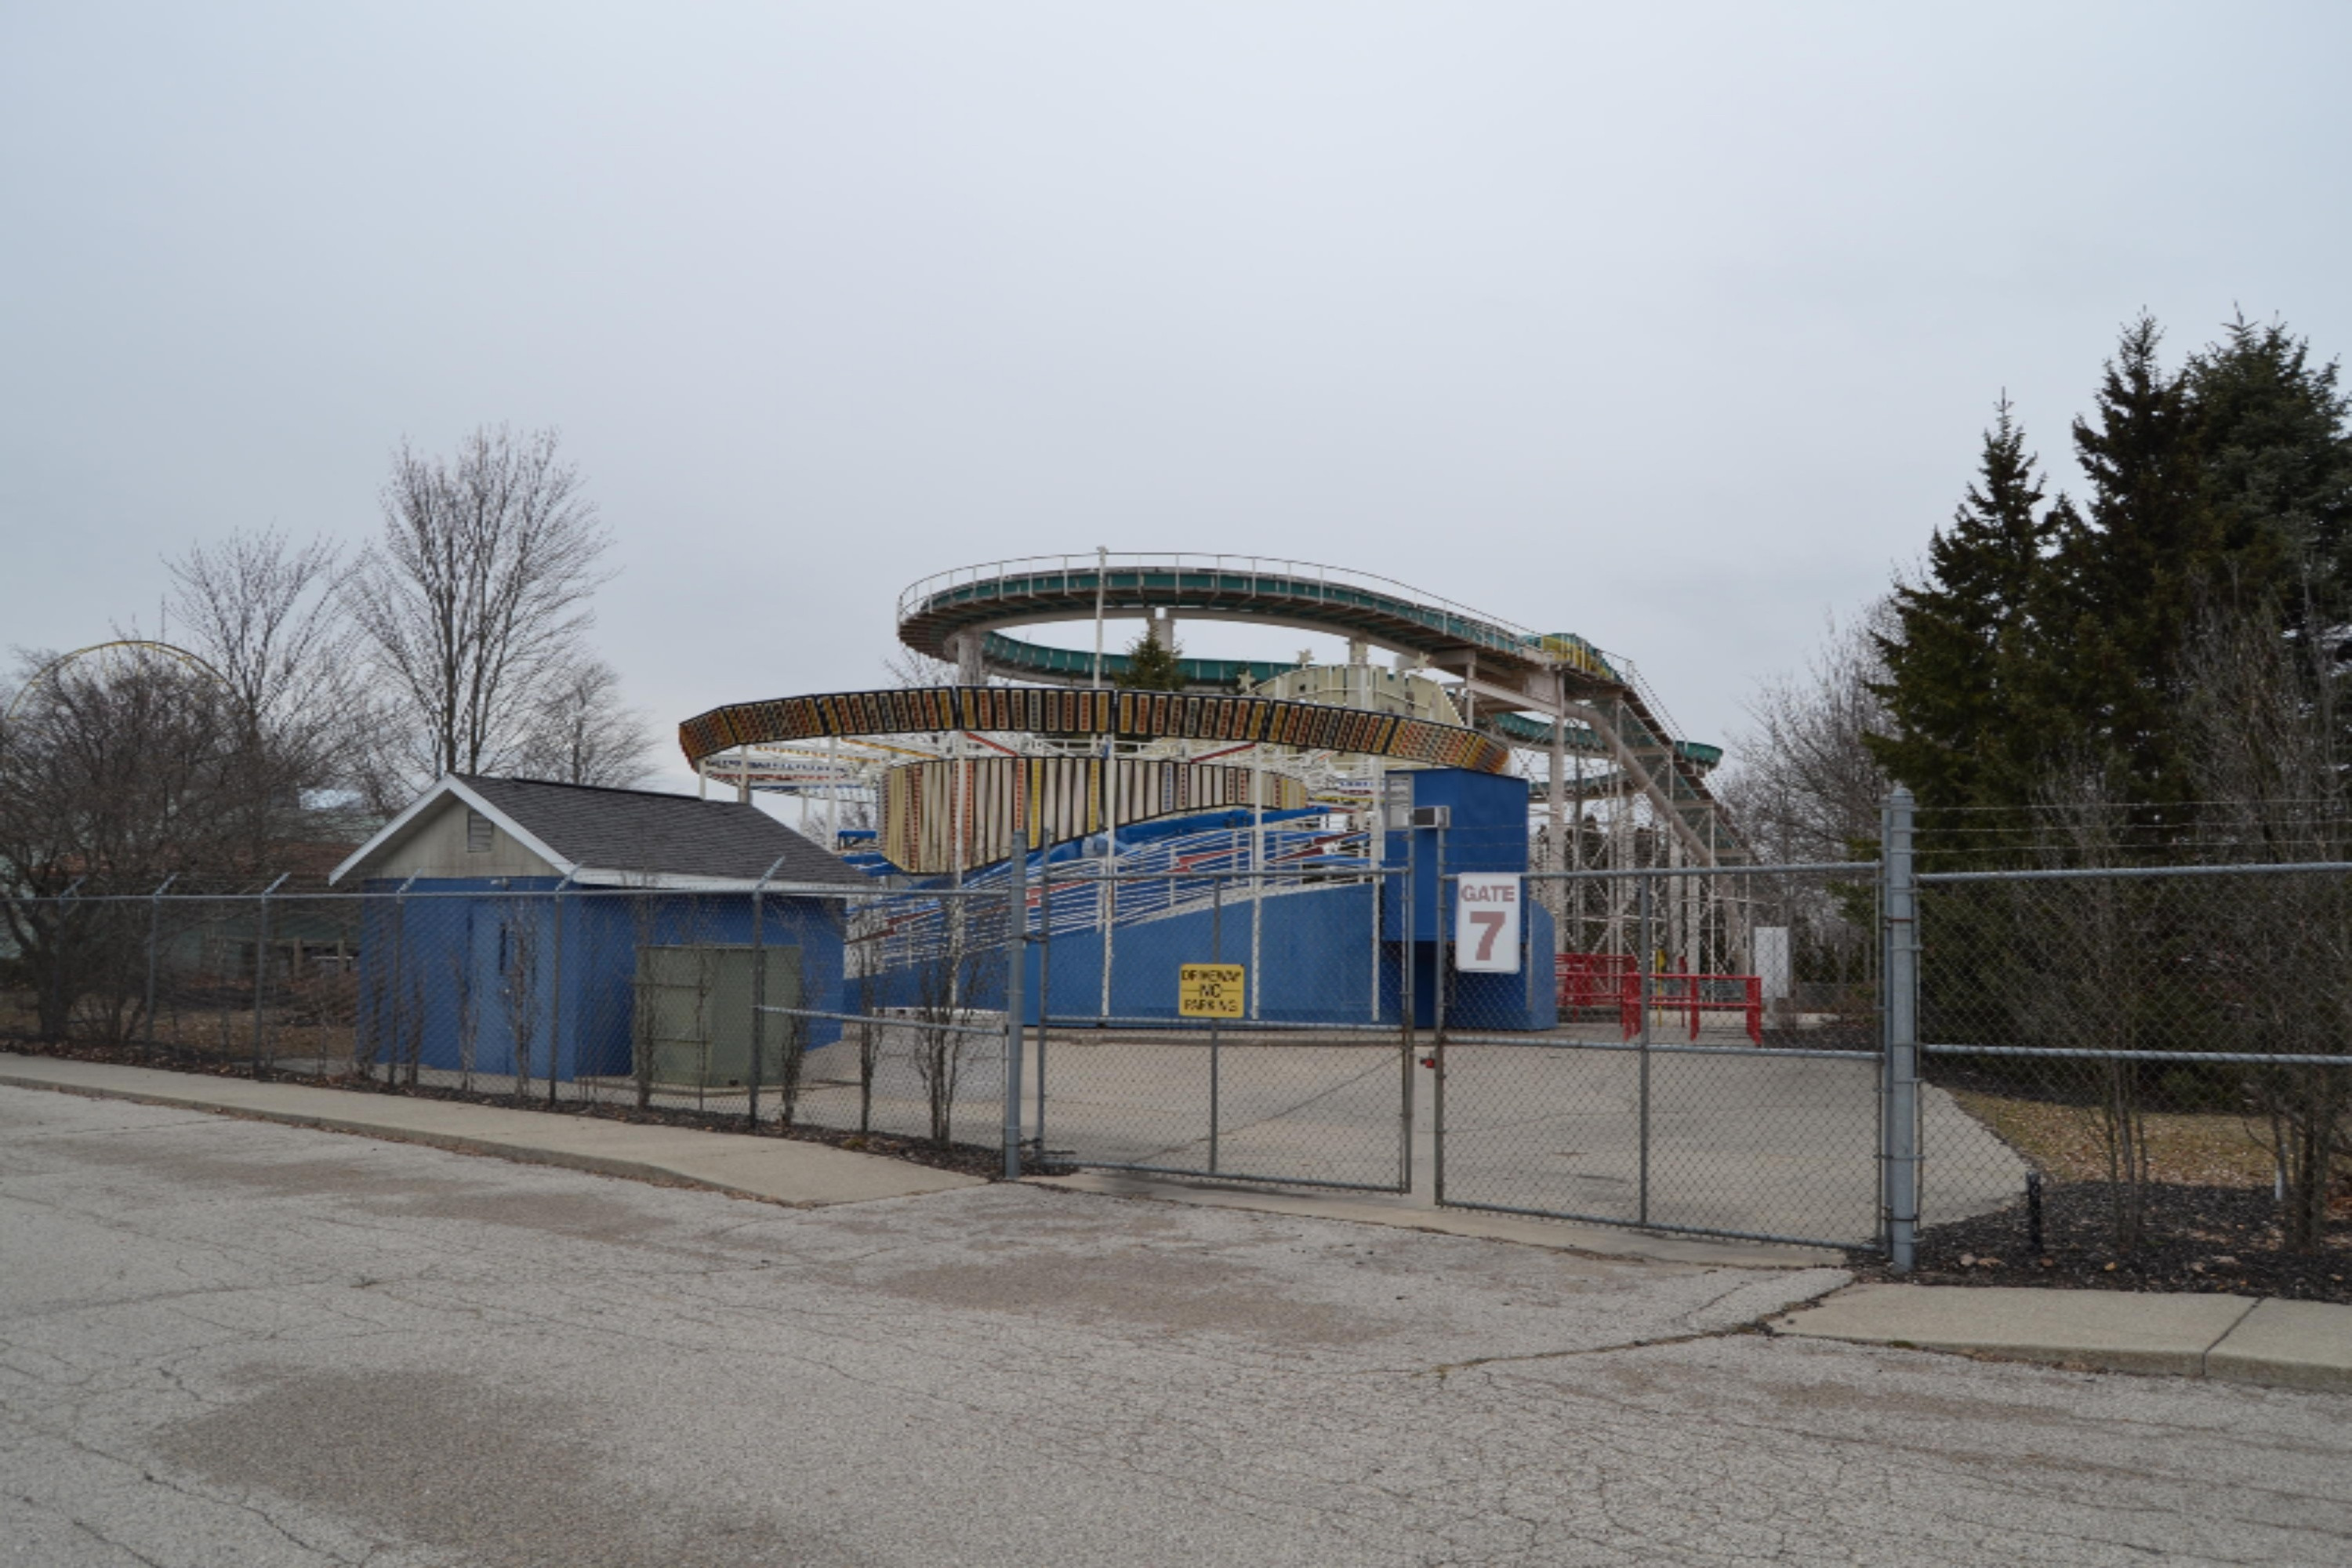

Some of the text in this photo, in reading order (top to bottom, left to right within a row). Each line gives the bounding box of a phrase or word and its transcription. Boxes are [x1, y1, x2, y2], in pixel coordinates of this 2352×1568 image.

[1461, 884, 1515, 902] GATE
[1470, 911, 1505, 960] 7
[1181, 970, 1241, 982] DRIVEWAY
[1200, 983, 1221, 998] NO
[1184, 999, 1236, 1012] PARKING
